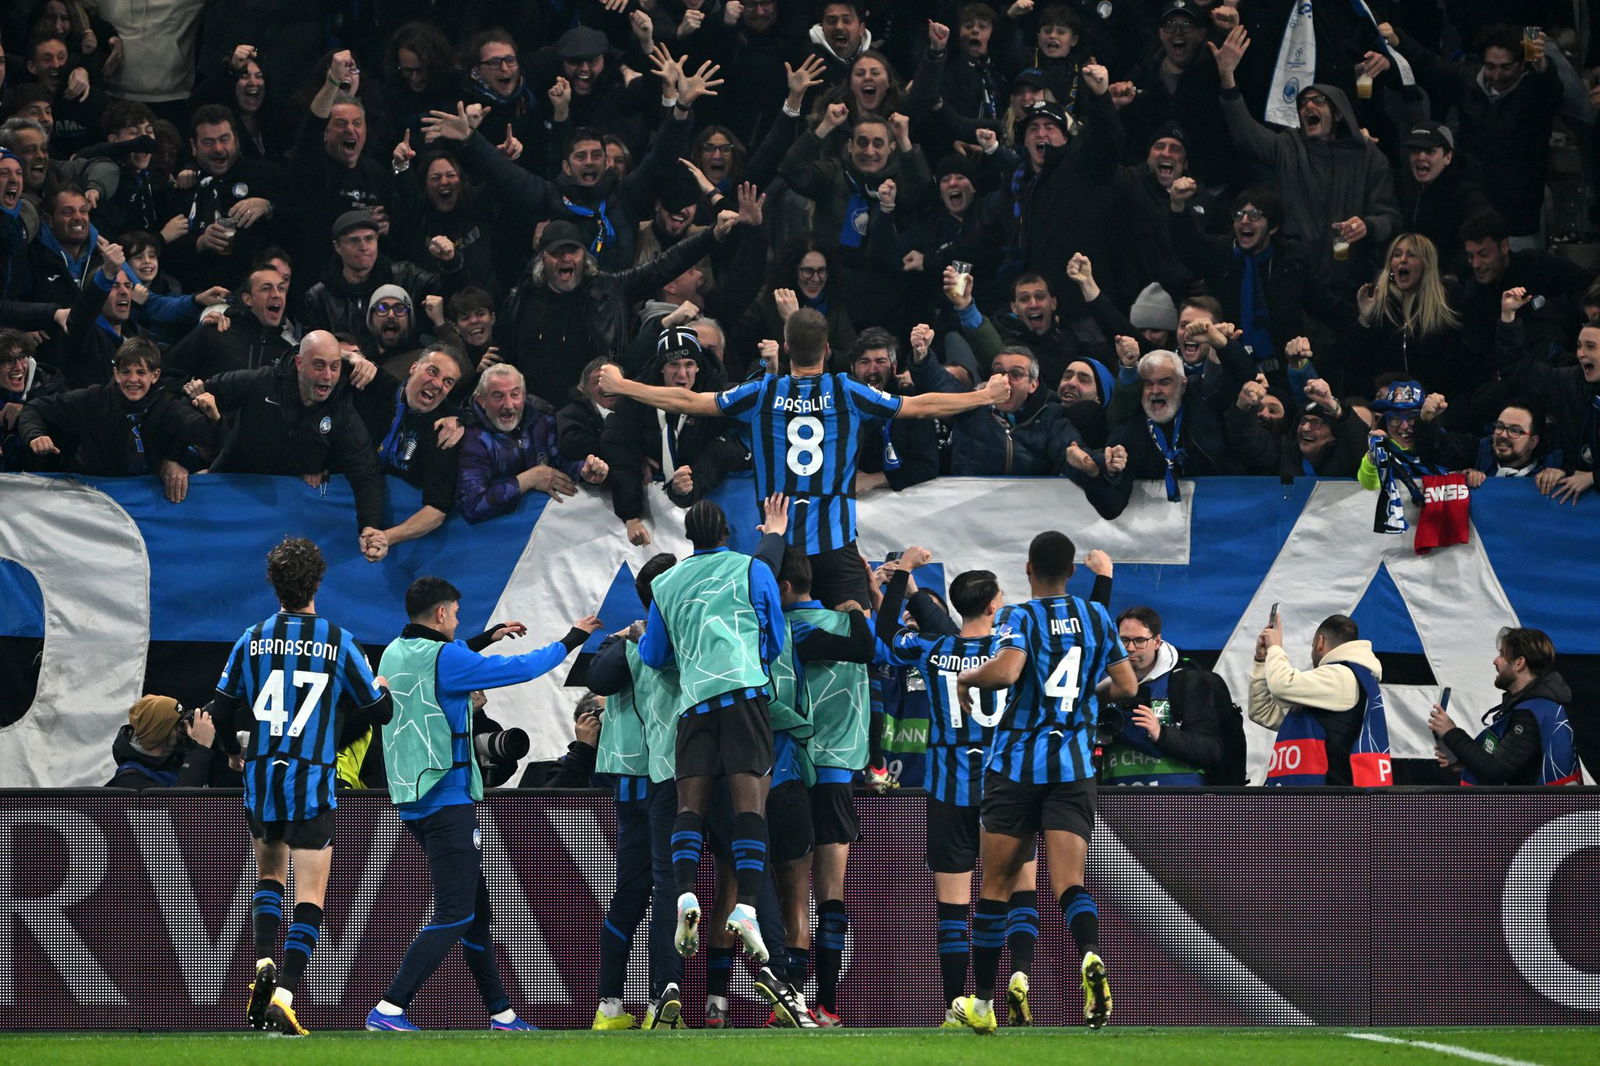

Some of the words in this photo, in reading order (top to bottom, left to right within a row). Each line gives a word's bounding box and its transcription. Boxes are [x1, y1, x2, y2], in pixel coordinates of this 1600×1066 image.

[774, 392, 832, 413] PAŠALIĆ
[787, 416, 825, 476] 8
[1051, 618, 1082, 636] HIEN
[249, 637, 338, 662] BERNASCONI
[1044, 646, 1083, 712] 4
[252, 669, 330, 737] 47
[881, 724, 927, 743] HANN
